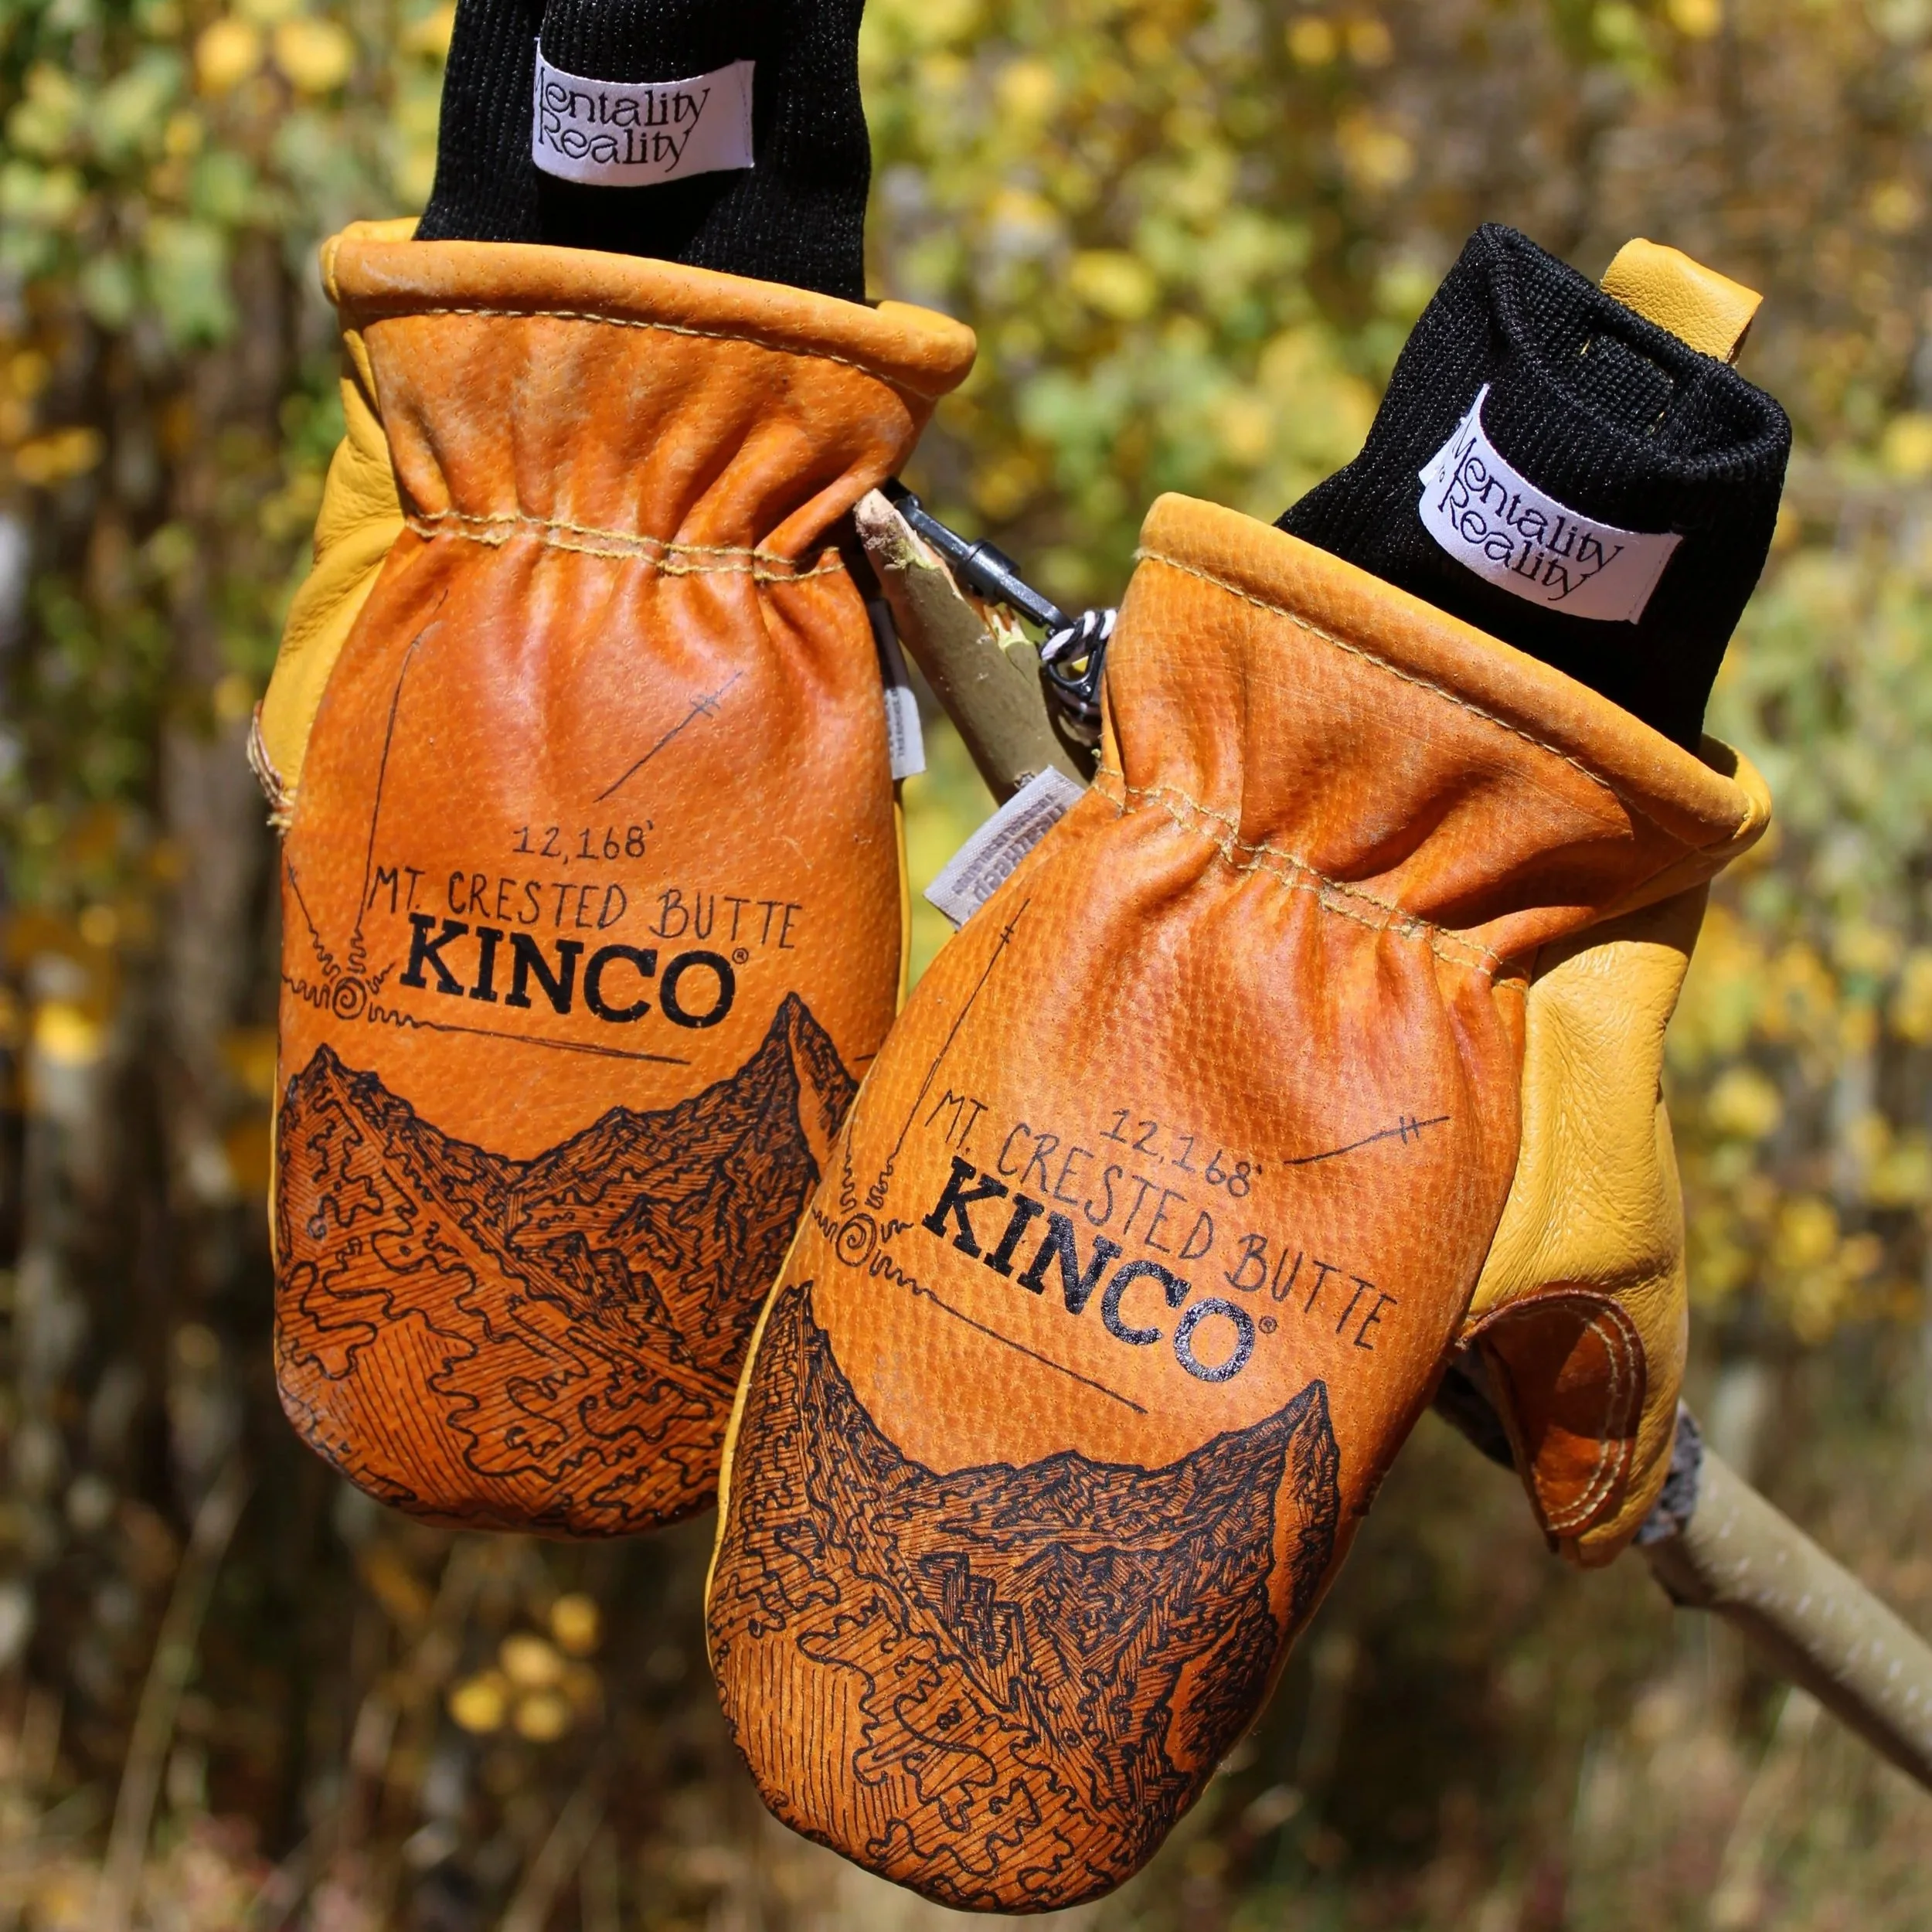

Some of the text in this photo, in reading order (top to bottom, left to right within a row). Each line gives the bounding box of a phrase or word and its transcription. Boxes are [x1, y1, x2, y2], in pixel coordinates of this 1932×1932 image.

[538, 106, 692, 172] Reality
[1437, 473, 1590, 600] Reality
[1451, 417, 1624, 577] Mentality
[512, 820, 654, 865] 12,168'
[367, 866, 803, 950] MT. CRESTED BUTTE
[925, 1088, 1398, 1351] MT. CRESTED BUTTE
